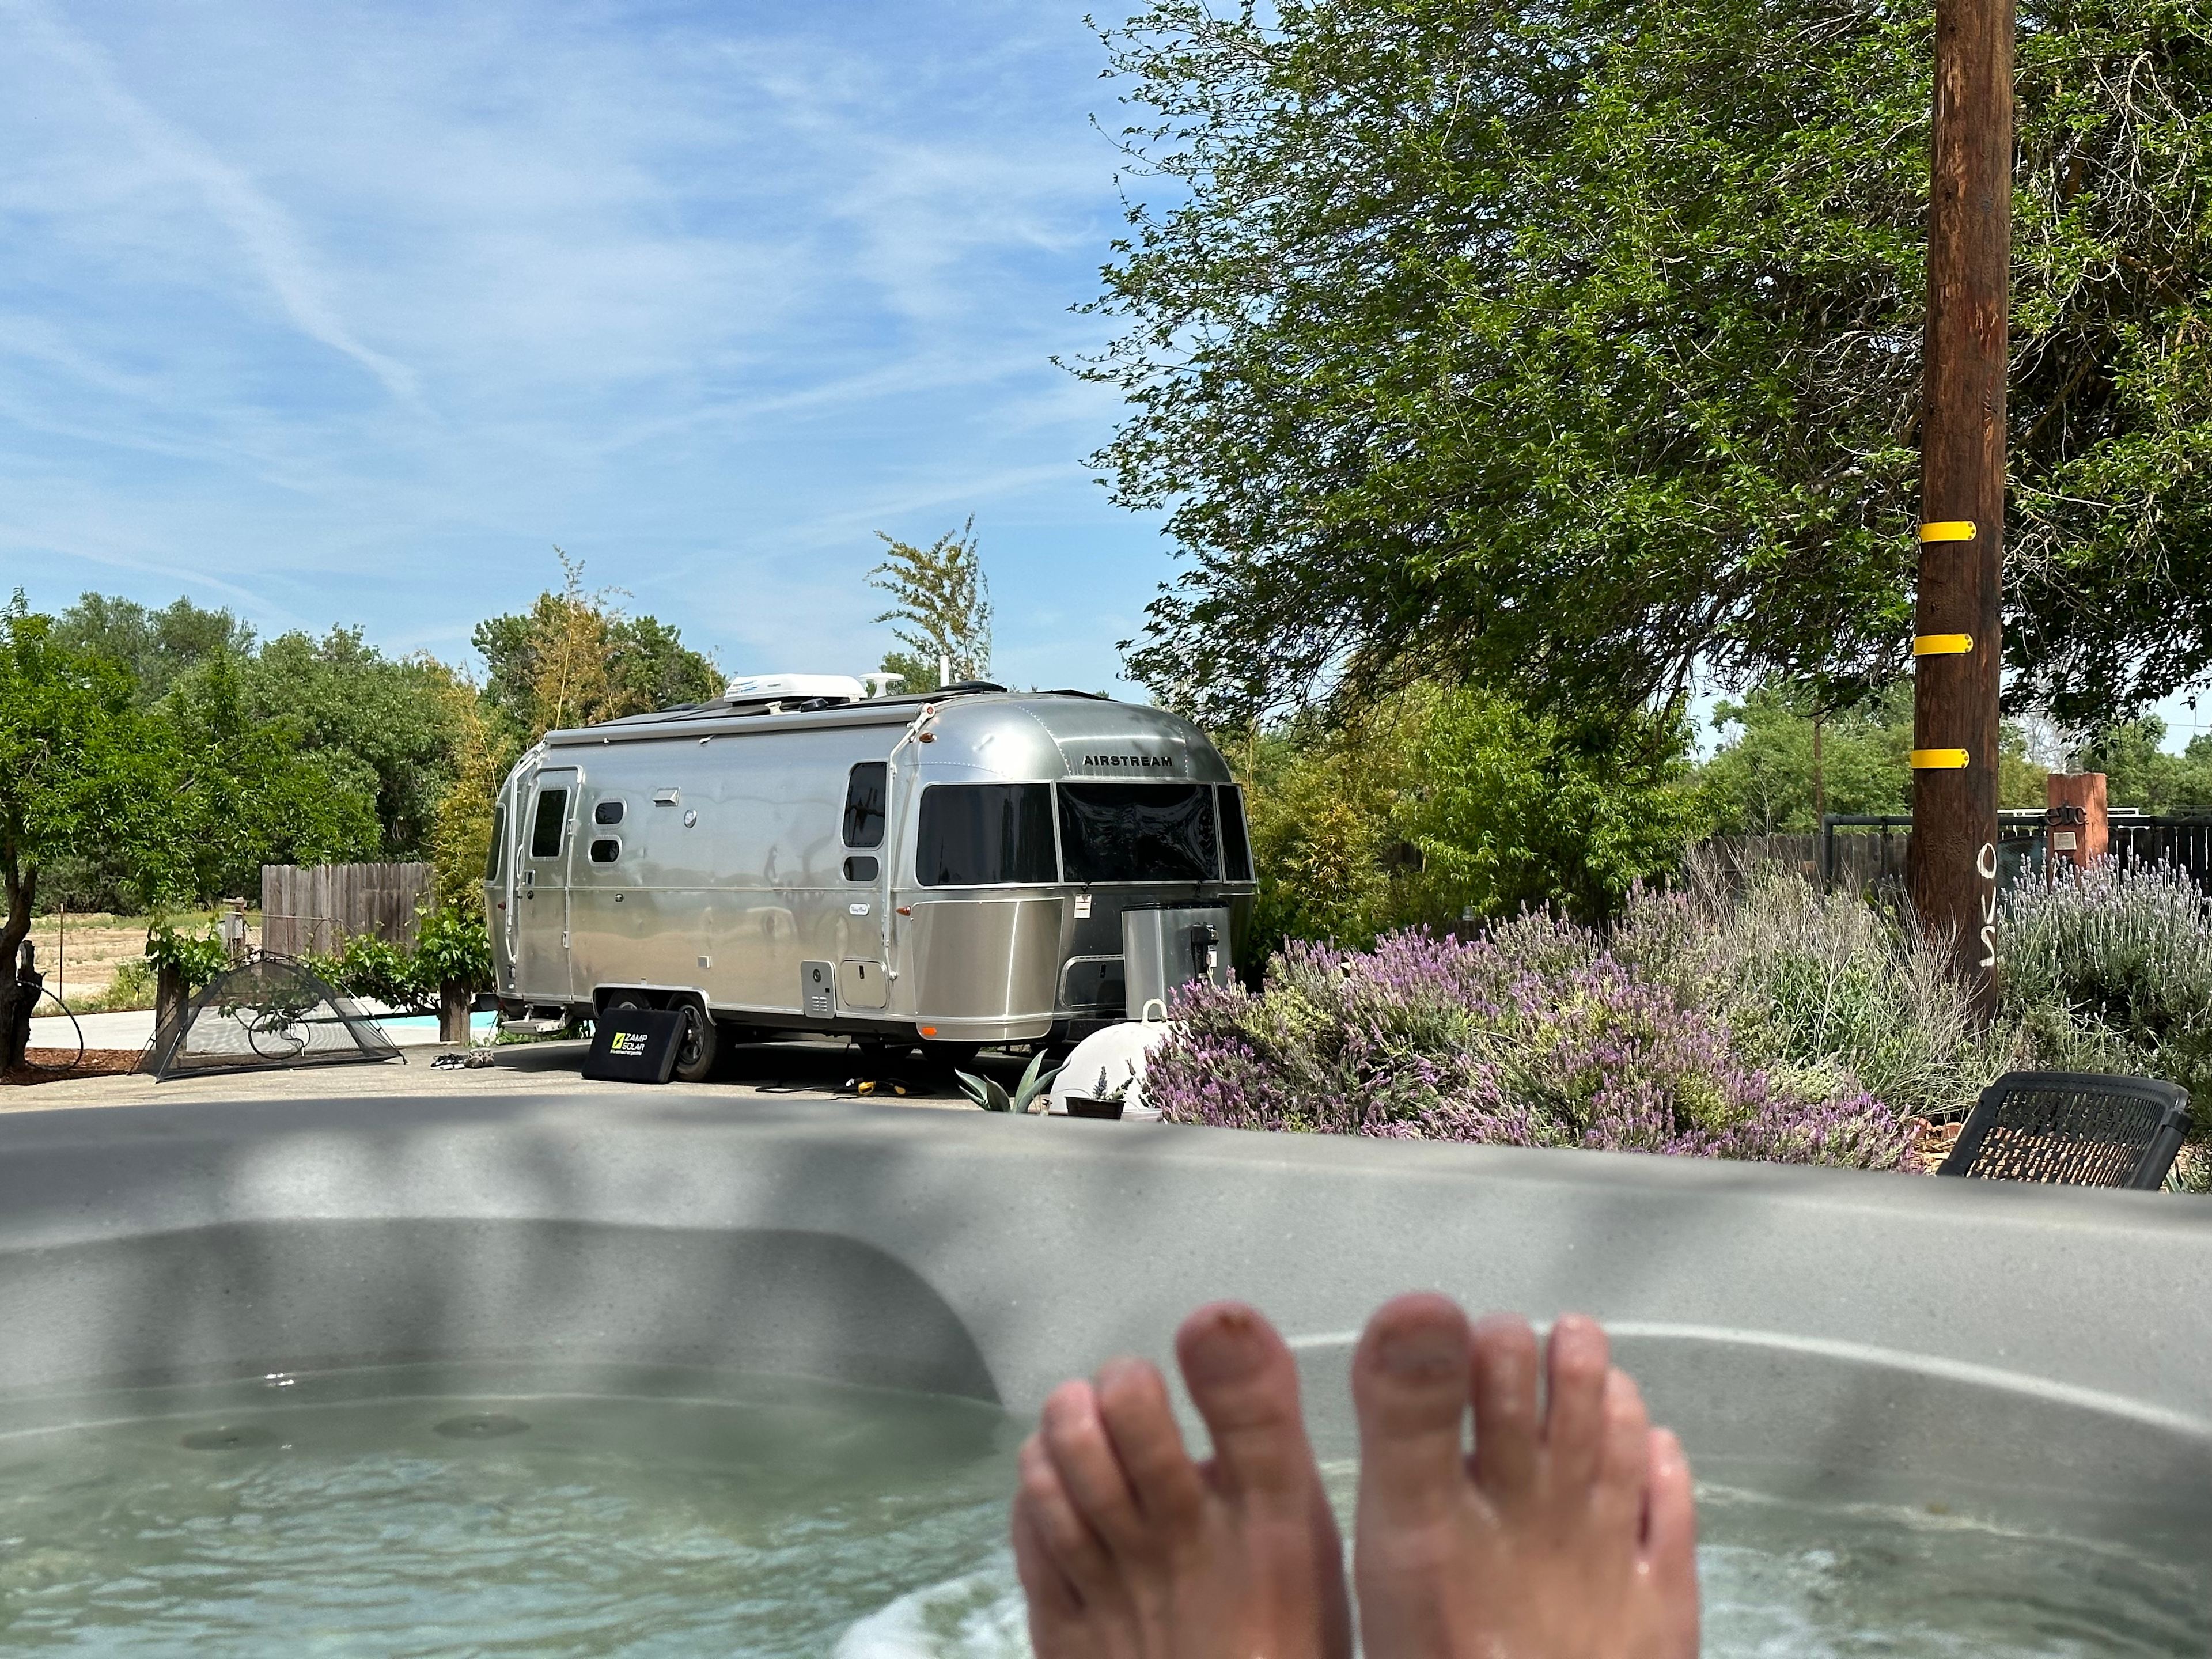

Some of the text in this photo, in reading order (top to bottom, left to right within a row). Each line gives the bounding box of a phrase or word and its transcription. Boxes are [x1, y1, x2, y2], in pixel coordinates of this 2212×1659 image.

[1083, 755, 1173, 767] AIRSTREAM
[624, 1033, 648, 1042] ZAMP
[622, 1041, 645, 1051] SOLAR
